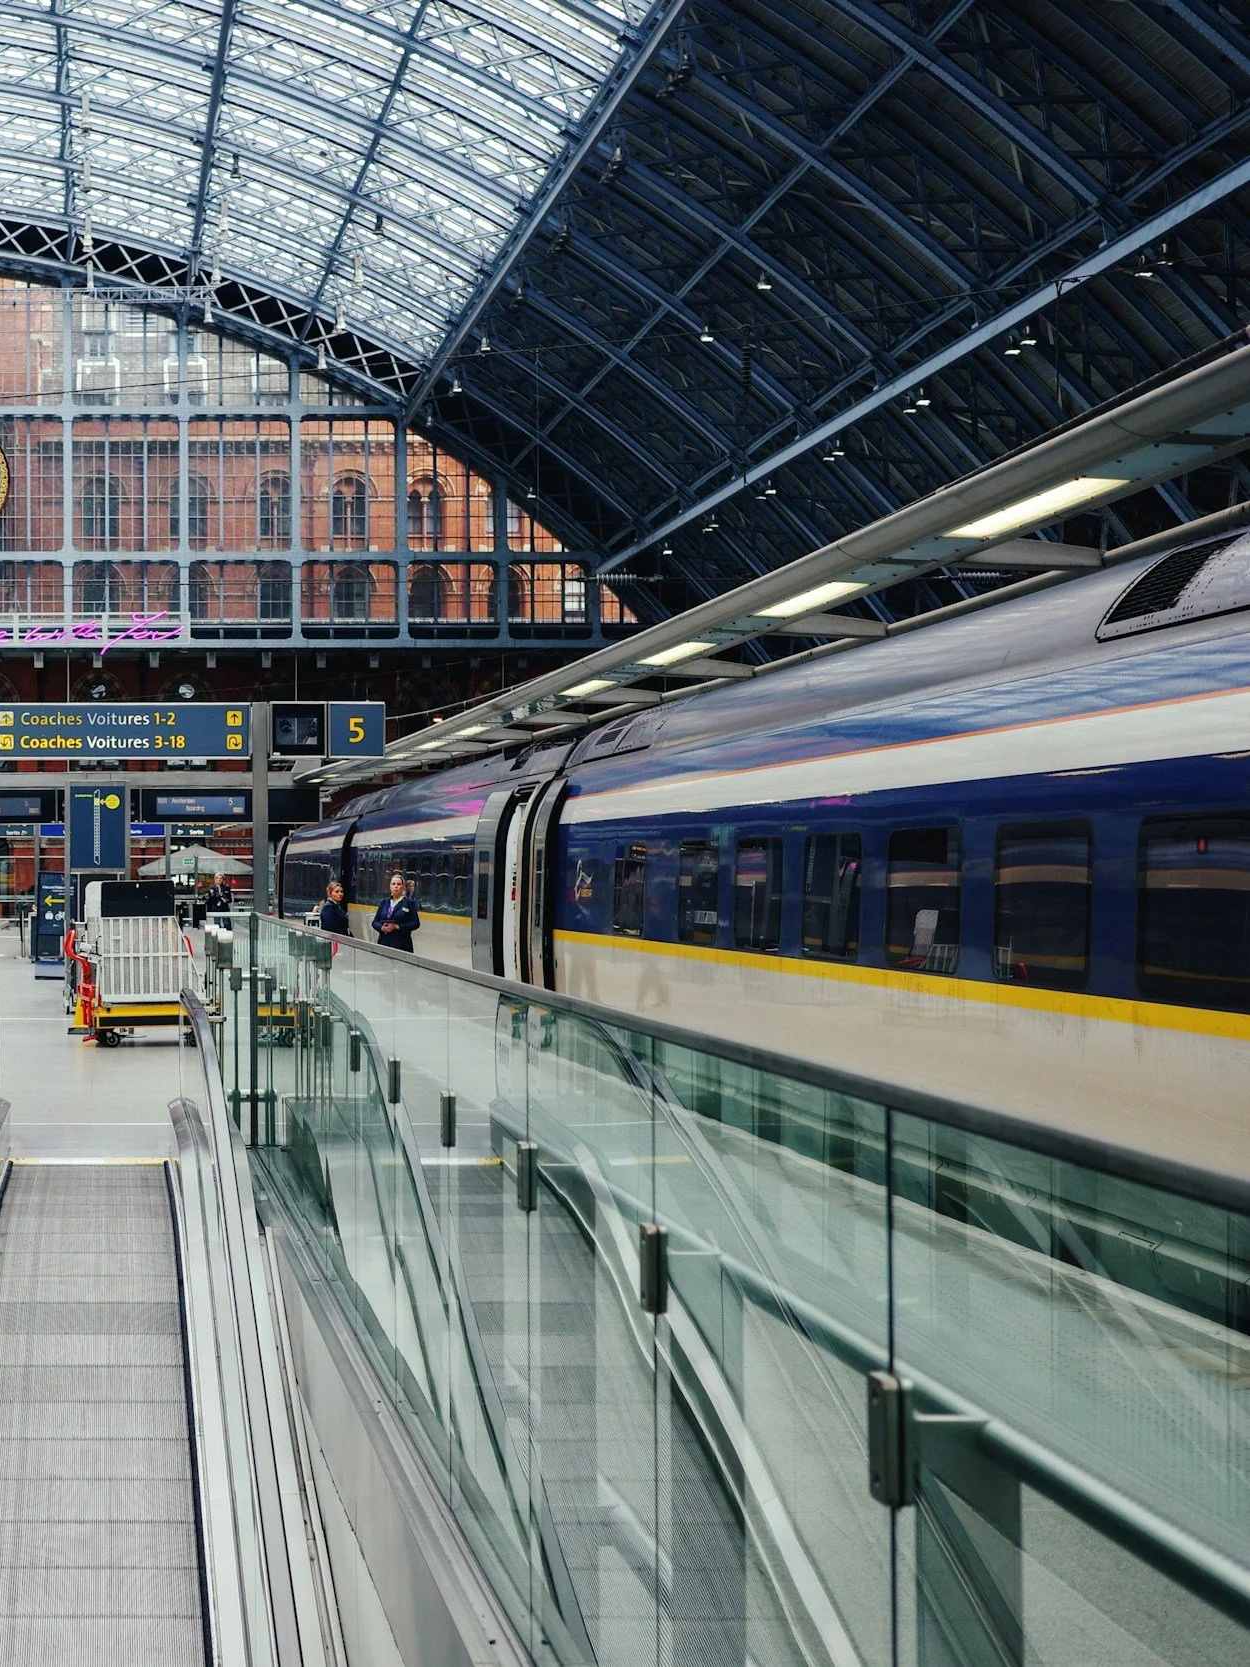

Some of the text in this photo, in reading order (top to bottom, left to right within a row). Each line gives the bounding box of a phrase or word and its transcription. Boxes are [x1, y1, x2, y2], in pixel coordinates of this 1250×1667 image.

[24, 619, 103, 645] with
[20, 712, 177, 726] Coaches Voitures 1-2
[349, 717, 366, 743] 5
[20, 735, 186, 749] Coaches Voitures 3-18
[228, 797, 234, 806] 5
